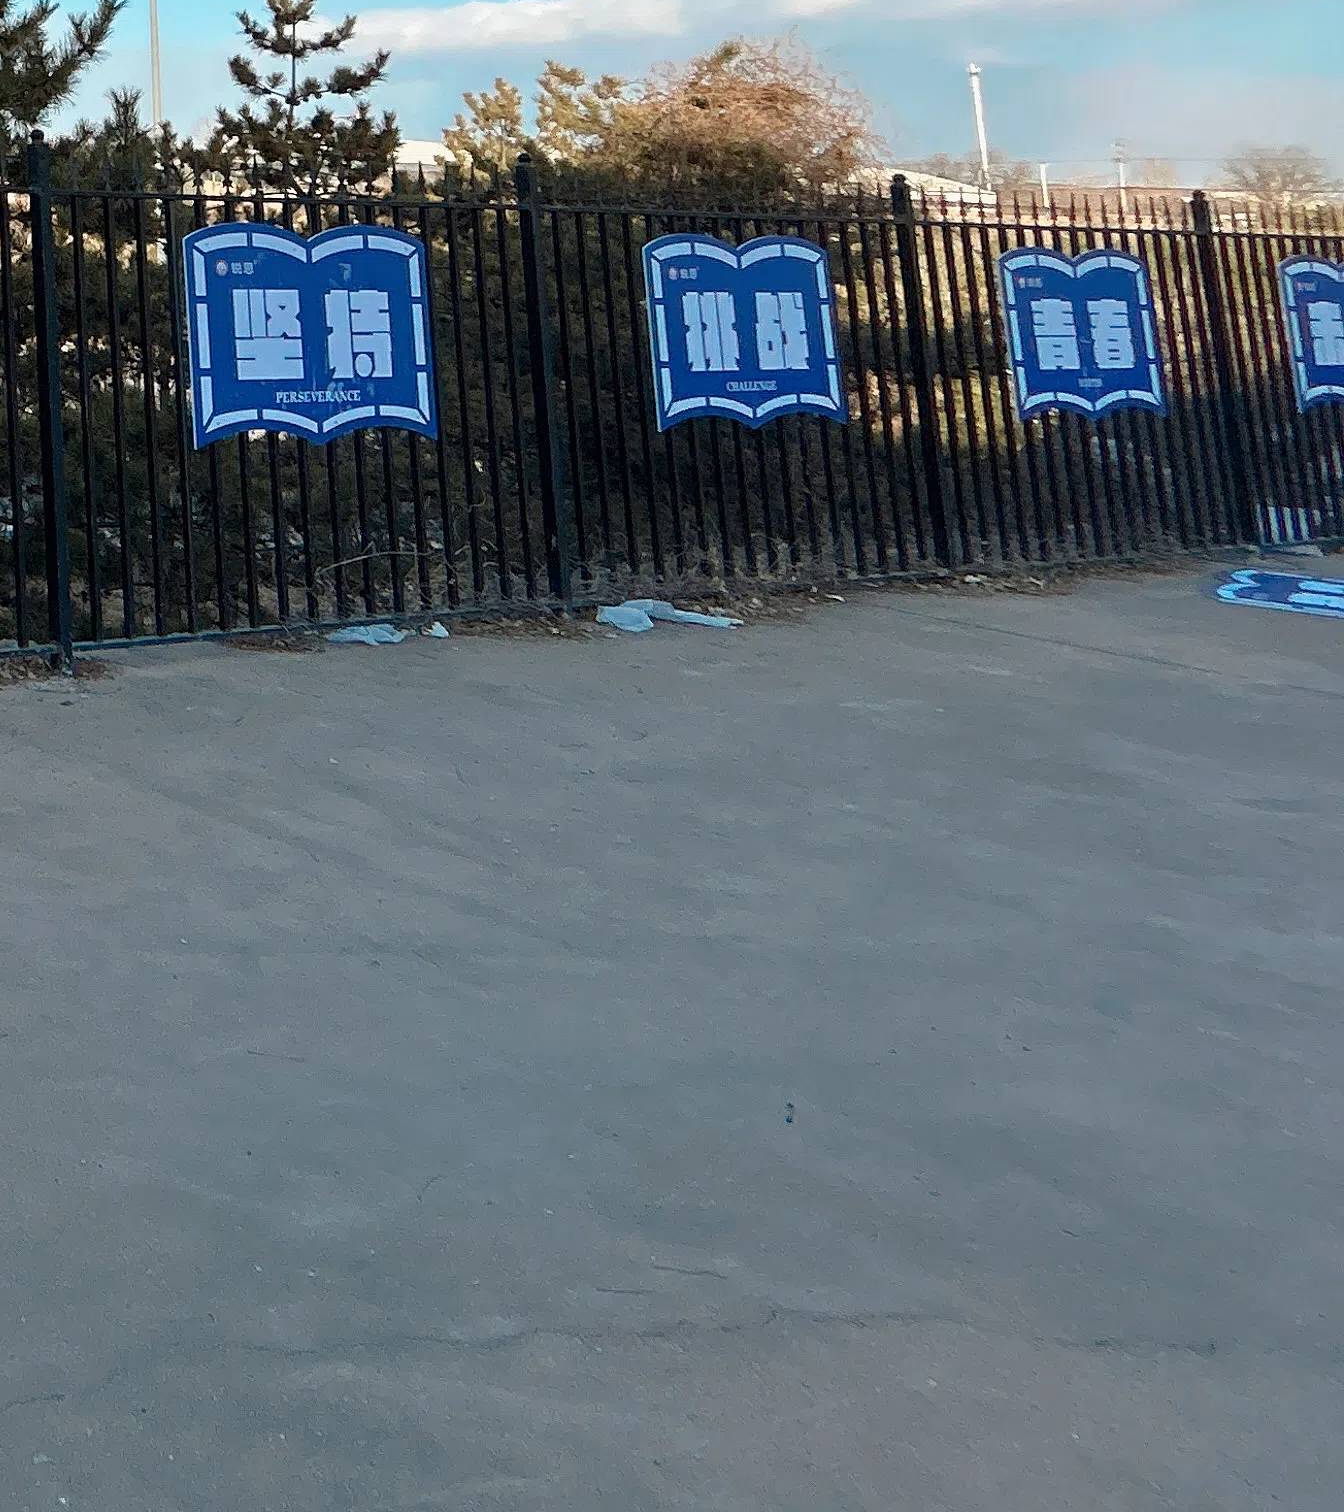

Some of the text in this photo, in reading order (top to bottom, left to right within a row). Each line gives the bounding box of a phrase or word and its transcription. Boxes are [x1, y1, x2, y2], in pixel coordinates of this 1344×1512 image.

[232, 289, 393, 381] 坚持
[682, 291, 810, 372] 挑战
[275, 390, 361, 404] PERSEVERANCE
